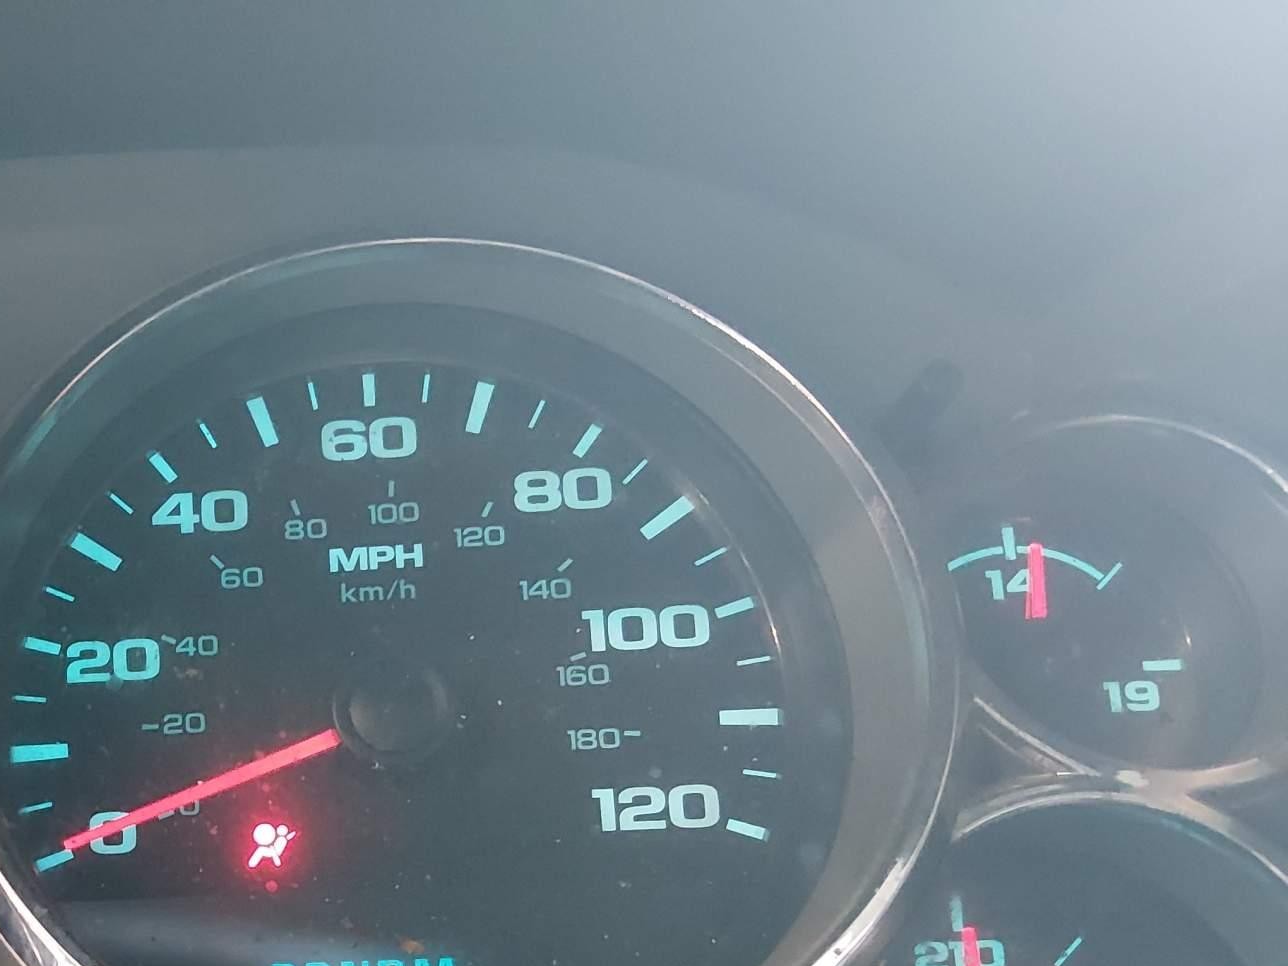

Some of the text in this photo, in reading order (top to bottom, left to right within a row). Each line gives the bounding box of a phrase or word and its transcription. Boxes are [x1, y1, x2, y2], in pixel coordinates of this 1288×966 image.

[322, 417, 417, 461] 60
[514, 468, 612, 512] 80
[152, 490, 248, 533] 40
[368, 502, 419, 524] 100
[285, 519, 327, 539] 80
[454, 526, 504, 547] 120
[329, 544, 423, 572] MPH
[220, 566, 263, 589] 60
[520, 579, 571, 600] 140
[985, 569, 1030, 600] 14
[341, 579, 415, 602] km/h
[582, 605, 709, 651] 100
[176, 636, 218, 656] 40
[66, 636, 162, 684] 20
[557, 664, 611, 686] 160
[1104, 681, 1159, 712] 19
[164, 713, 205, 734] 20
[568, 728, 620, 750] 180
[592, 784, 720, 831] 120
[89, 811, 137, 855] 0
